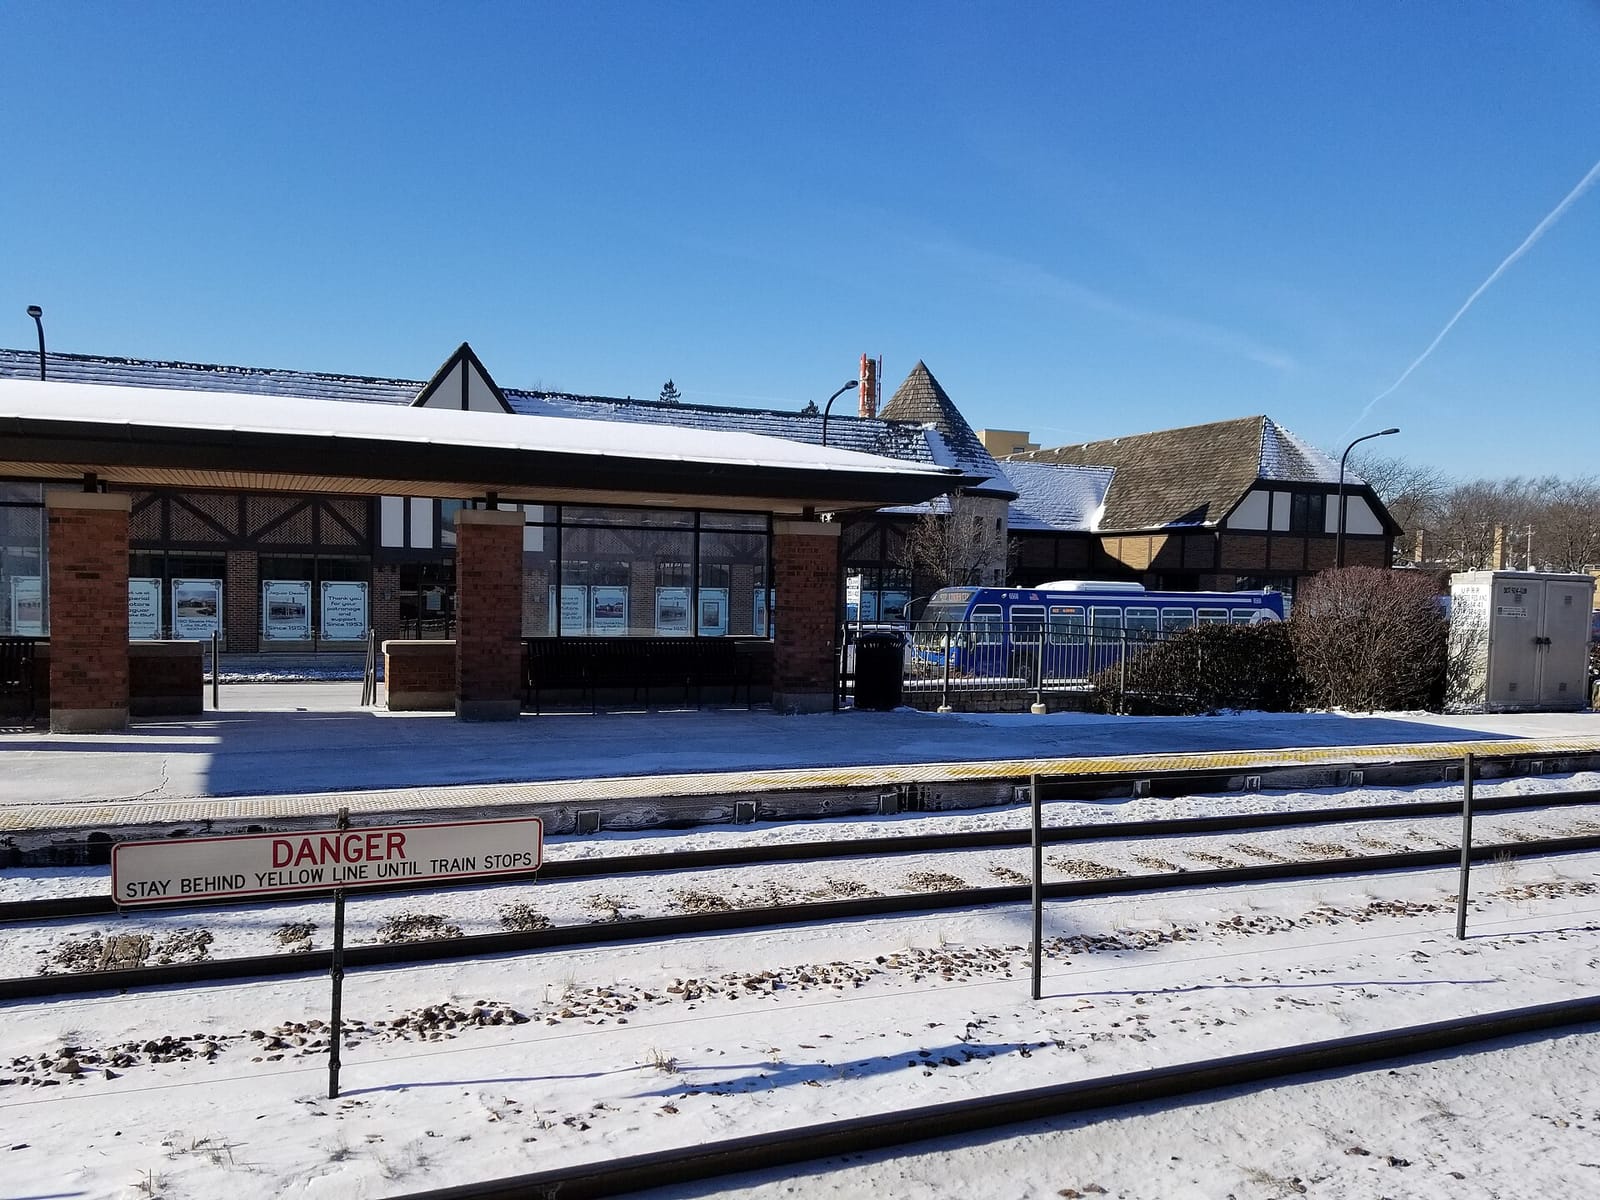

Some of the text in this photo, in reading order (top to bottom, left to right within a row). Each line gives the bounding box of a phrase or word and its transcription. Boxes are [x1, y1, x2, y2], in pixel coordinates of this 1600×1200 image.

[272, 831, 407, 869] DANGER
[126, 852, 532, 898] STAY BEHIND YELLOW LINE UNTIL TRAIN STOPS
